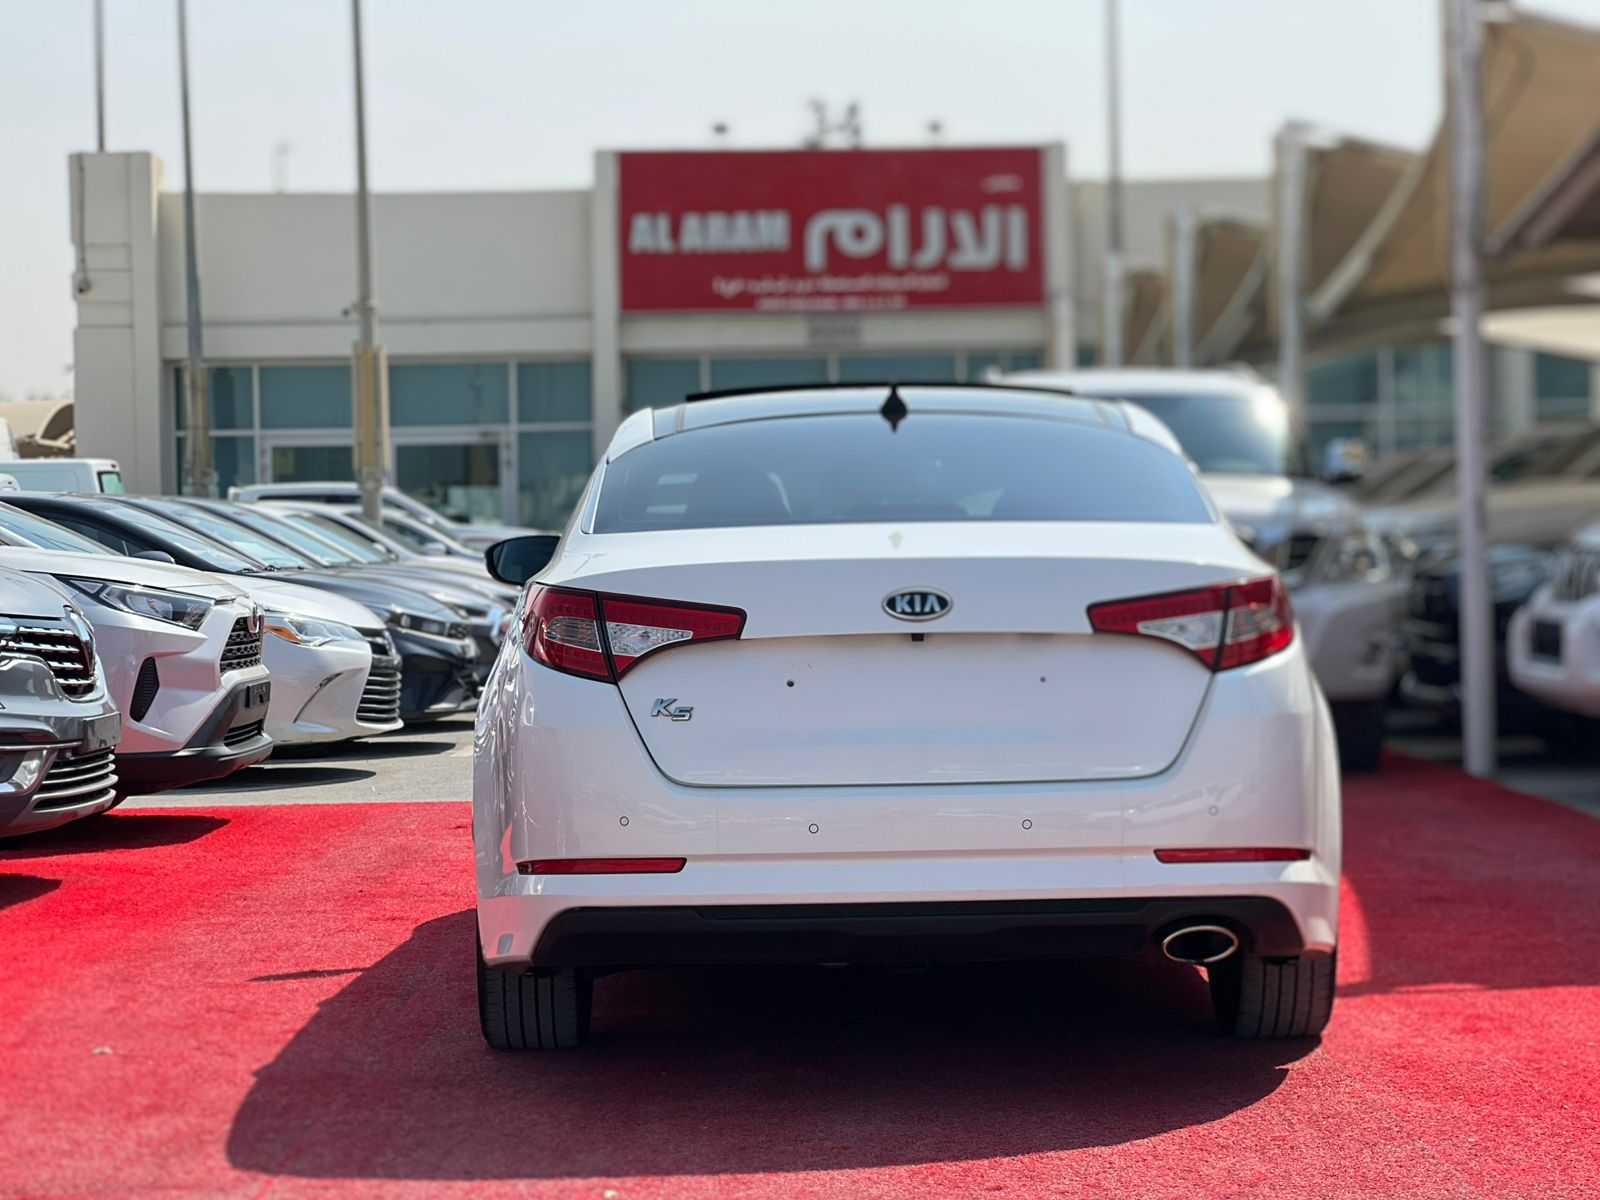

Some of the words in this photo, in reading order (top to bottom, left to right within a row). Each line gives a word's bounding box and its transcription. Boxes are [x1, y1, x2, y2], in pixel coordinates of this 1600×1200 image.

[630, 211, 674, 253] AL
[895, 594, 940, 613] KIA
[651, 698, 693, 721] K5
